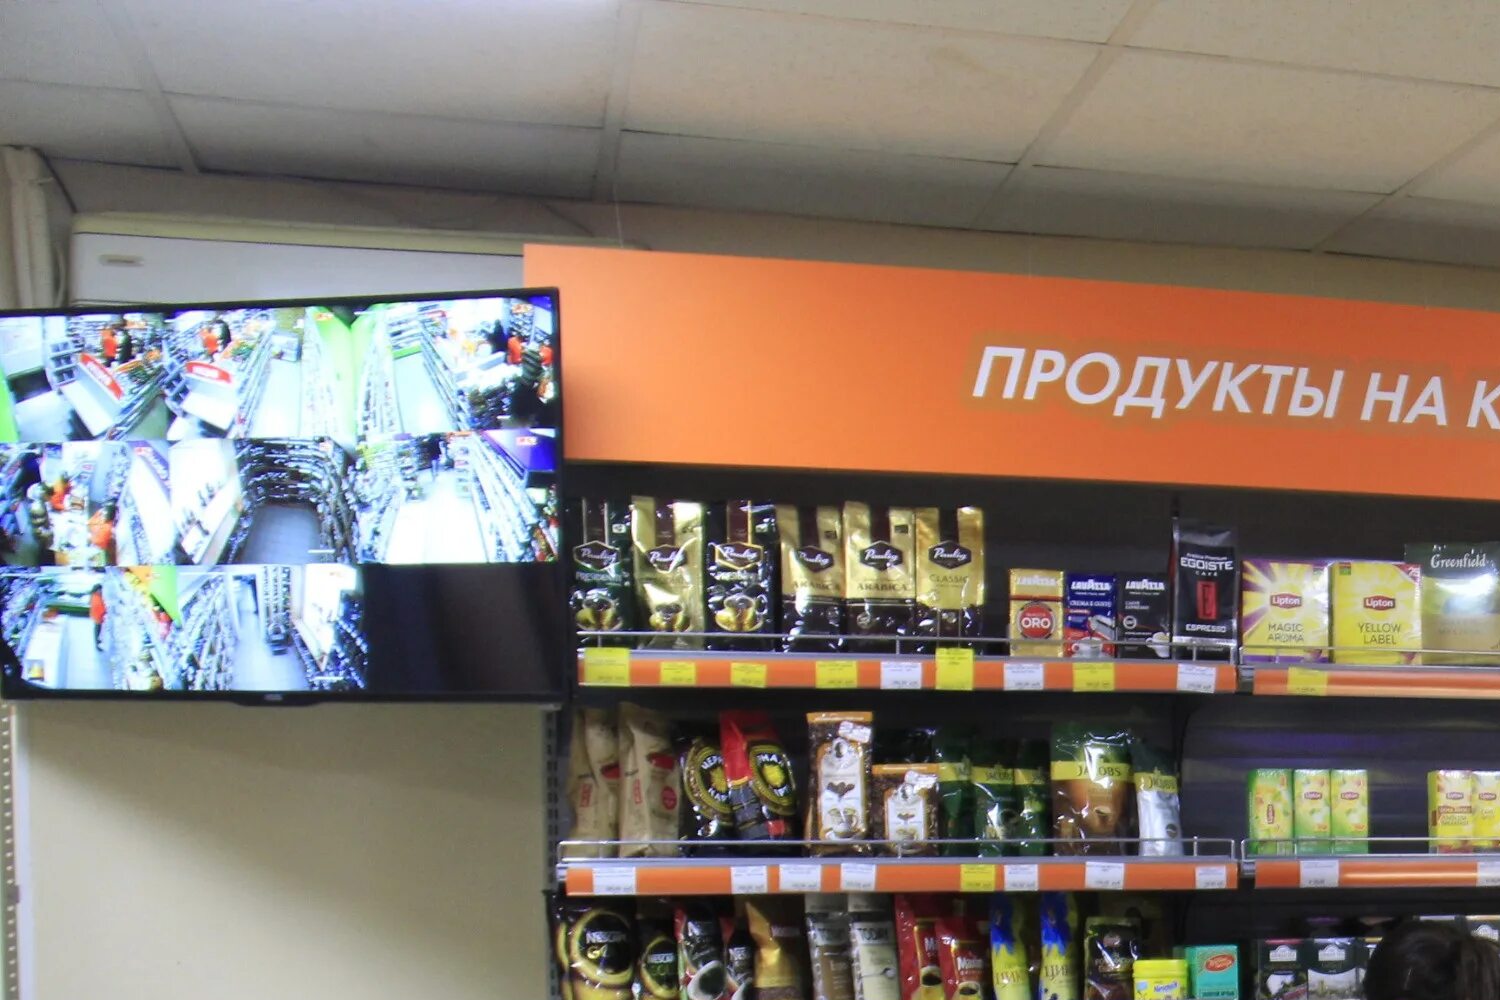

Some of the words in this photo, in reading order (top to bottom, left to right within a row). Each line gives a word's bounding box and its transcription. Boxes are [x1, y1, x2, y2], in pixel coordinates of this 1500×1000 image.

[972, 345, 1344, 419] ПРОДУКТЫ
[1360, 372, 1448, 426] НА
[1180, 557, 1234, 571] EGOISTE
[1430, 552, 1487, 570] Greenfield
[1272, 595, 1300, 607] Lipton
[1365, 597, 1394, 610] Lipton
[1020, 617, 1051, 629] ORO
[1185, 623, 1227, 633] ESPRESSO
[1268, 623, 1304, 633] MAGIC
[1357, 623, 1402, 633] YELLOW
[1267, 633, 1304, 643] AROMA
[1363, 634, 1398, 645] LABEL
